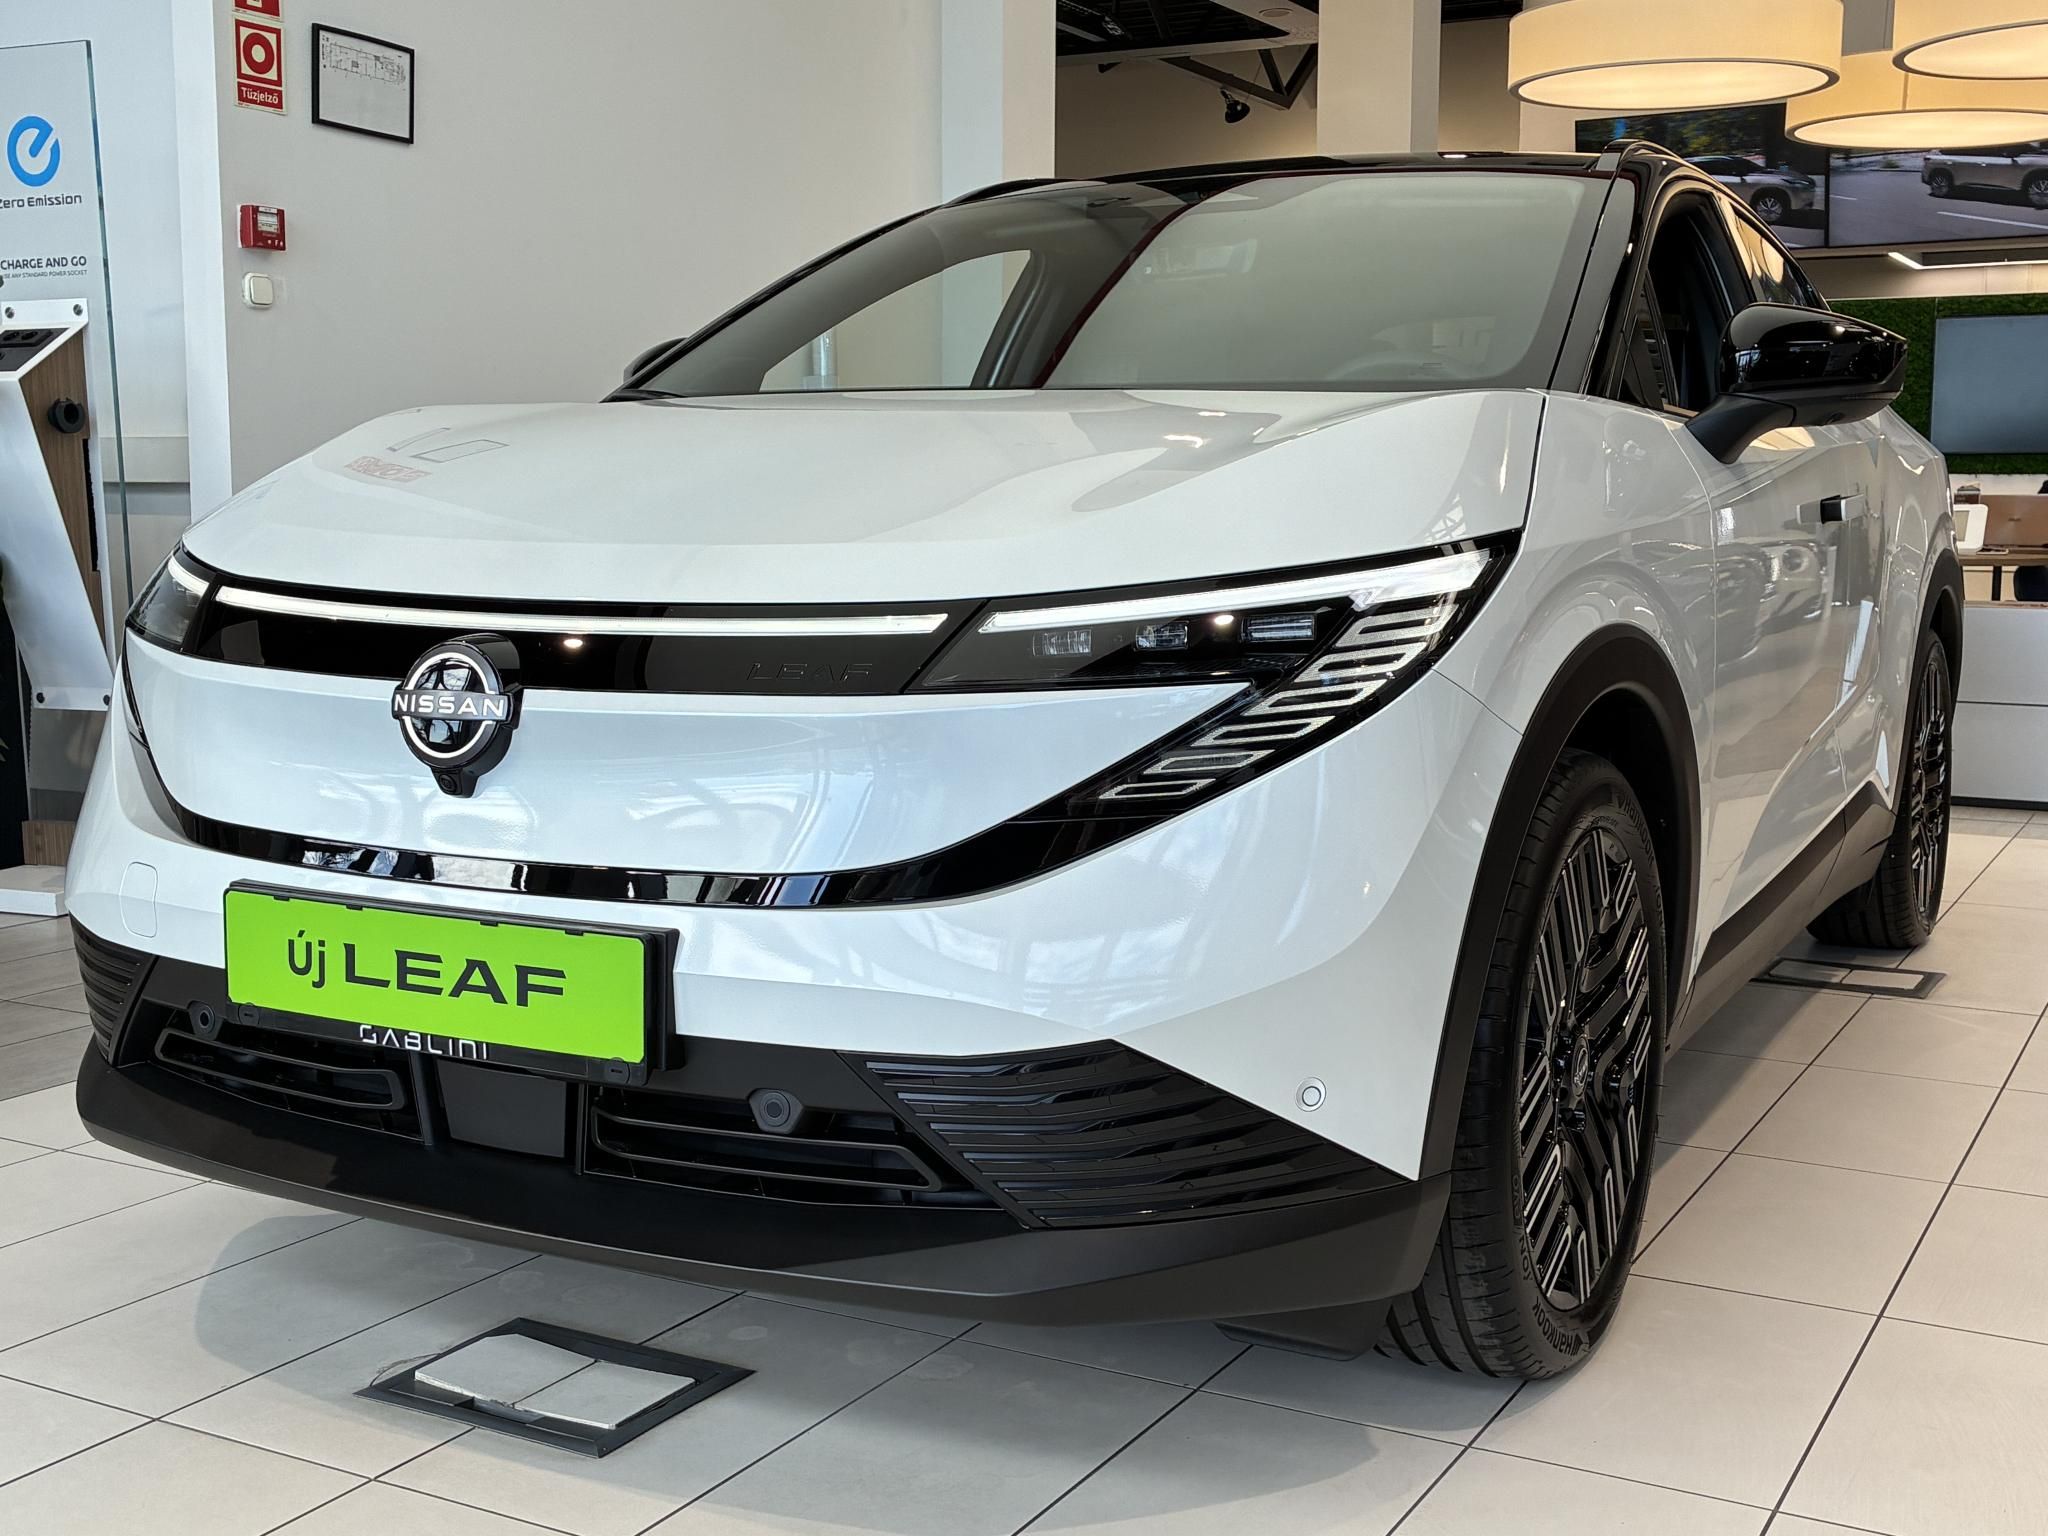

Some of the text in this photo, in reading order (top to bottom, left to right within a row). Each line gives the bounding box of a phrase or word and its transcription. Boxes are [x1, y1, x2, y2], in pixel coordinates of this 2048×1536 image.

[241, 87, 279, 104] Tűzjelző
[27, 193, 82, 207] Emission
[0, 255, 87, 270] CHARGE AND GO
[394, 694, 504, 717] NISSAN
[288, 929, 566, 1008] Új LEAF
[360, 1024, 487, 1060] GABLINI
